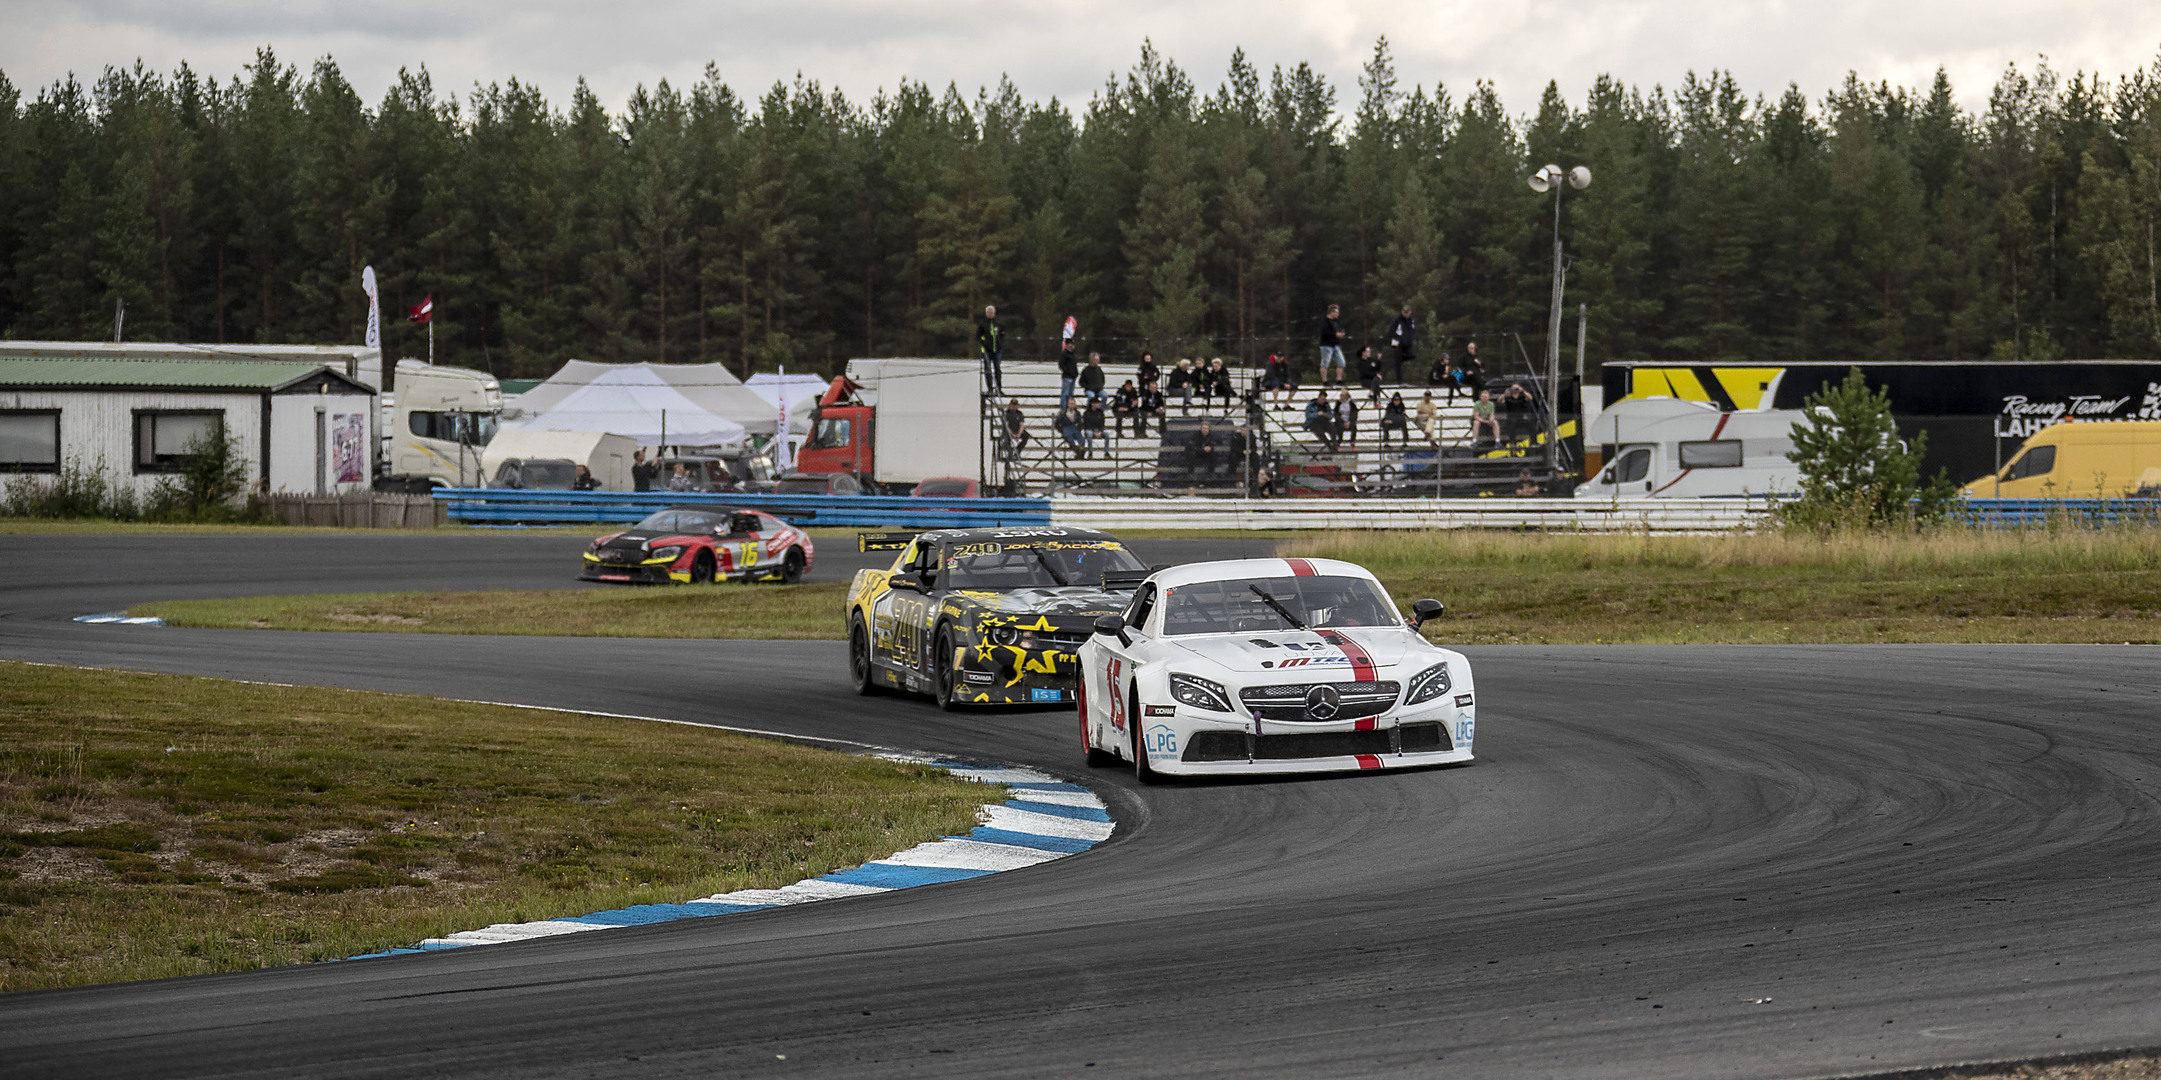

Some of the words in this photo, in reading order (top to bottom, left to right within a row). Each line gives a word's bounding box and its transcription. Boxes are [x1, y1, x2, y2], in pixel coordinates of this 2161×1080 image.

[2002, 395, 2067, 421] Racing
[2068, 394, 2131, 416] Team
[739, 541, 759, 567] 16
[953, 541, 1002, 559] 240
[892, 597, 924, 670] 240
[1034, 690, 1058, 700] ISE
[1106, 656, 1126, 737] 15
[1455, 720, 1474, 741] LPG
[1145, 733, 1178, 753] LPG
